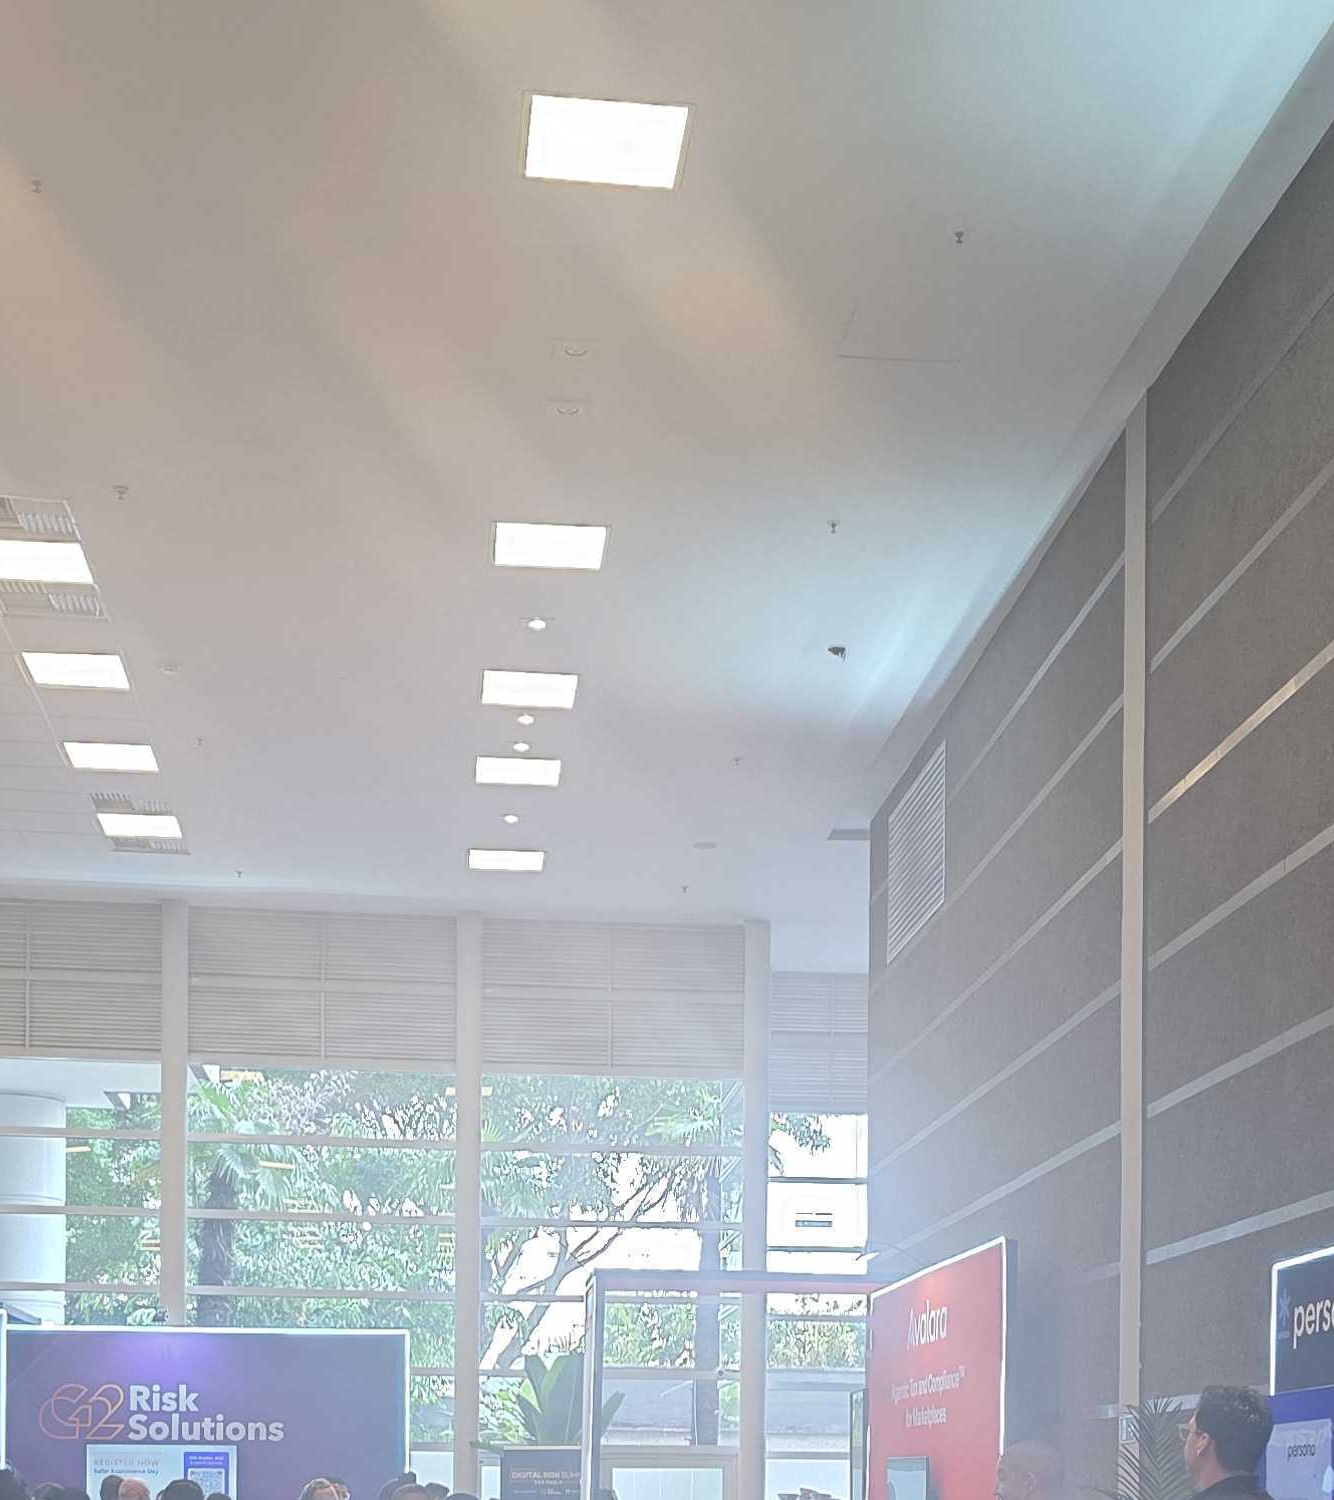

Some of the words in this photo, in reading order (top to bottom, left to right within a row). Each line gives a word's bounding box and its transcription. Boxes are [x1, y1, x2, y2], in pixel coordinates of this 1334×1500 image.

[907, 1298, 948, 1350] Avalara
[38, 1383, 124, 1440] G2
[129, 1384, 200, 1412] Risk
[128, 1413, 284, 1442] Solutions
[137, 1458, 159, 1467] NOW
[1286, 1442, 1316, 1462] persona
[511, 1471, 542, 1479] DIGITAL
